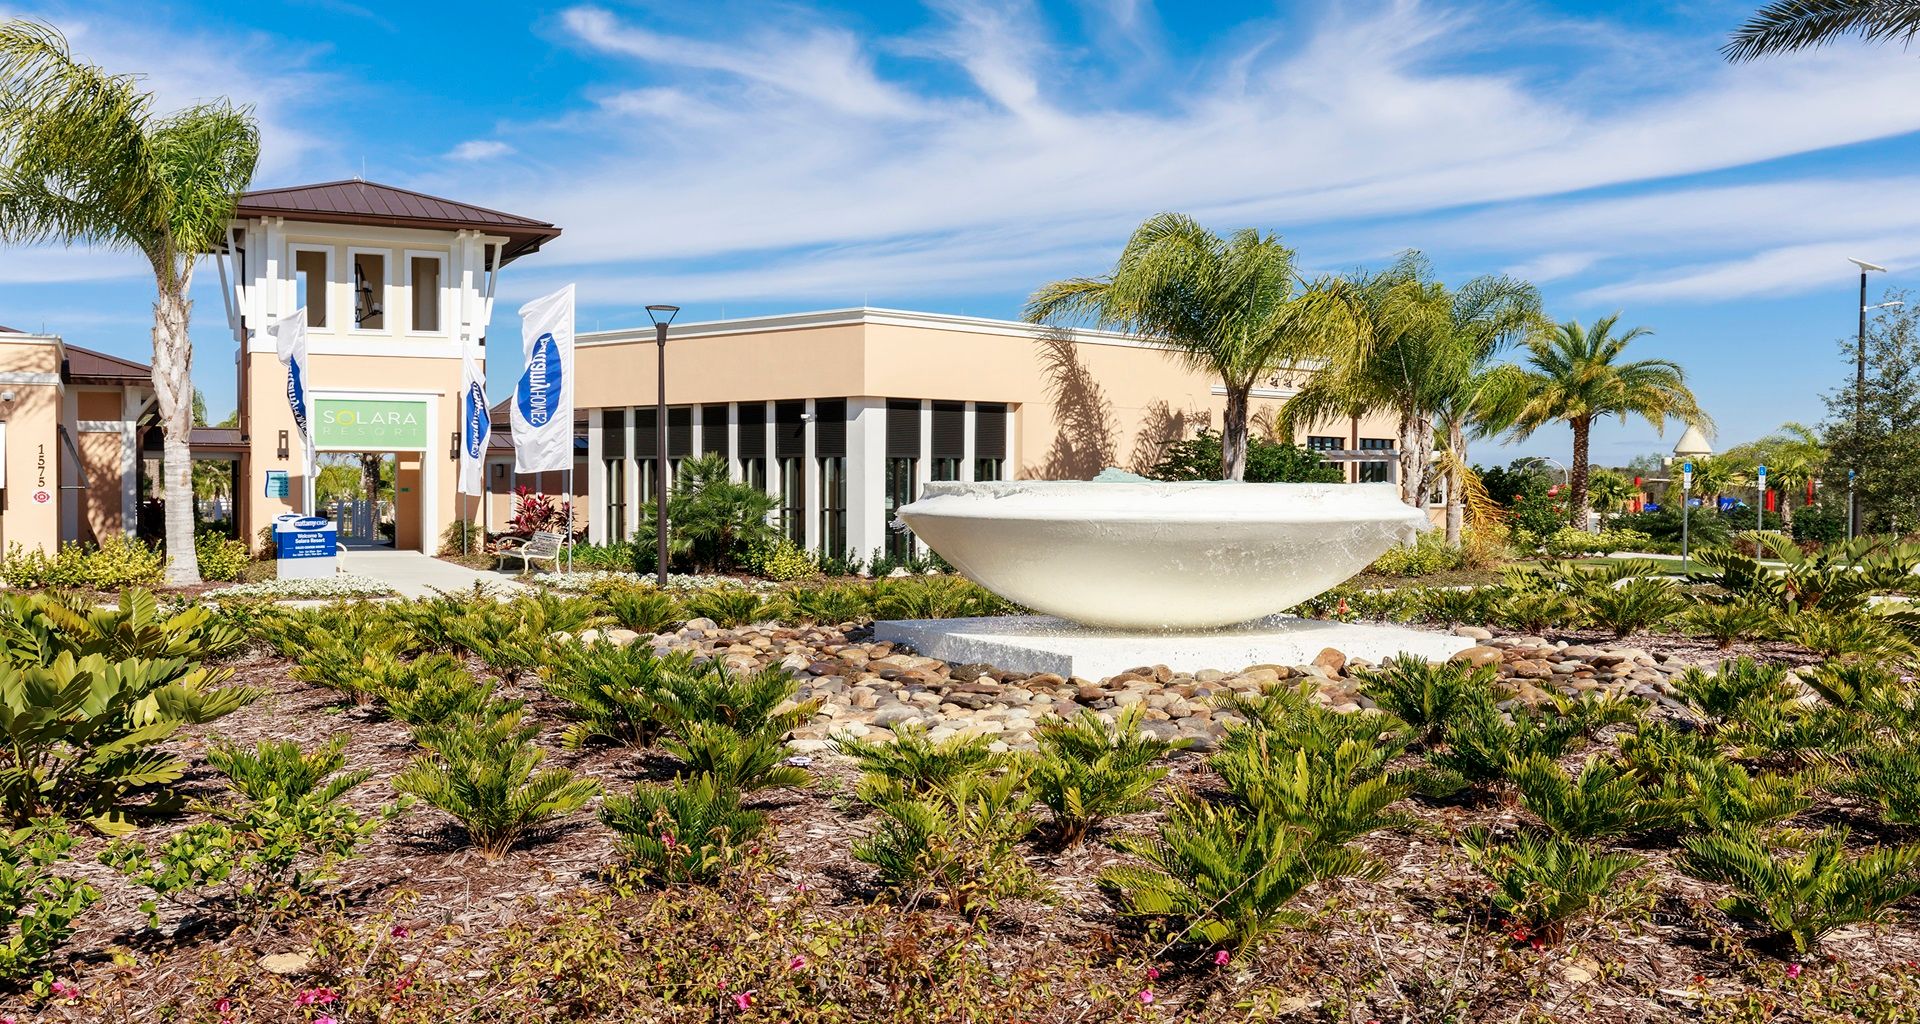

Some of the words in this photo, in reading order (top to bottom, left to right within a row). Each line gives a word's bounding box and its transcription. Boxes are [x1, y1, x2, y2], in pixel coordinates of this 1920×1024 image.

[323, 409, 417, 427] SOLARA
[323, 426, 417, 437] RESORT
[37, 443, 46, 488] 1575
